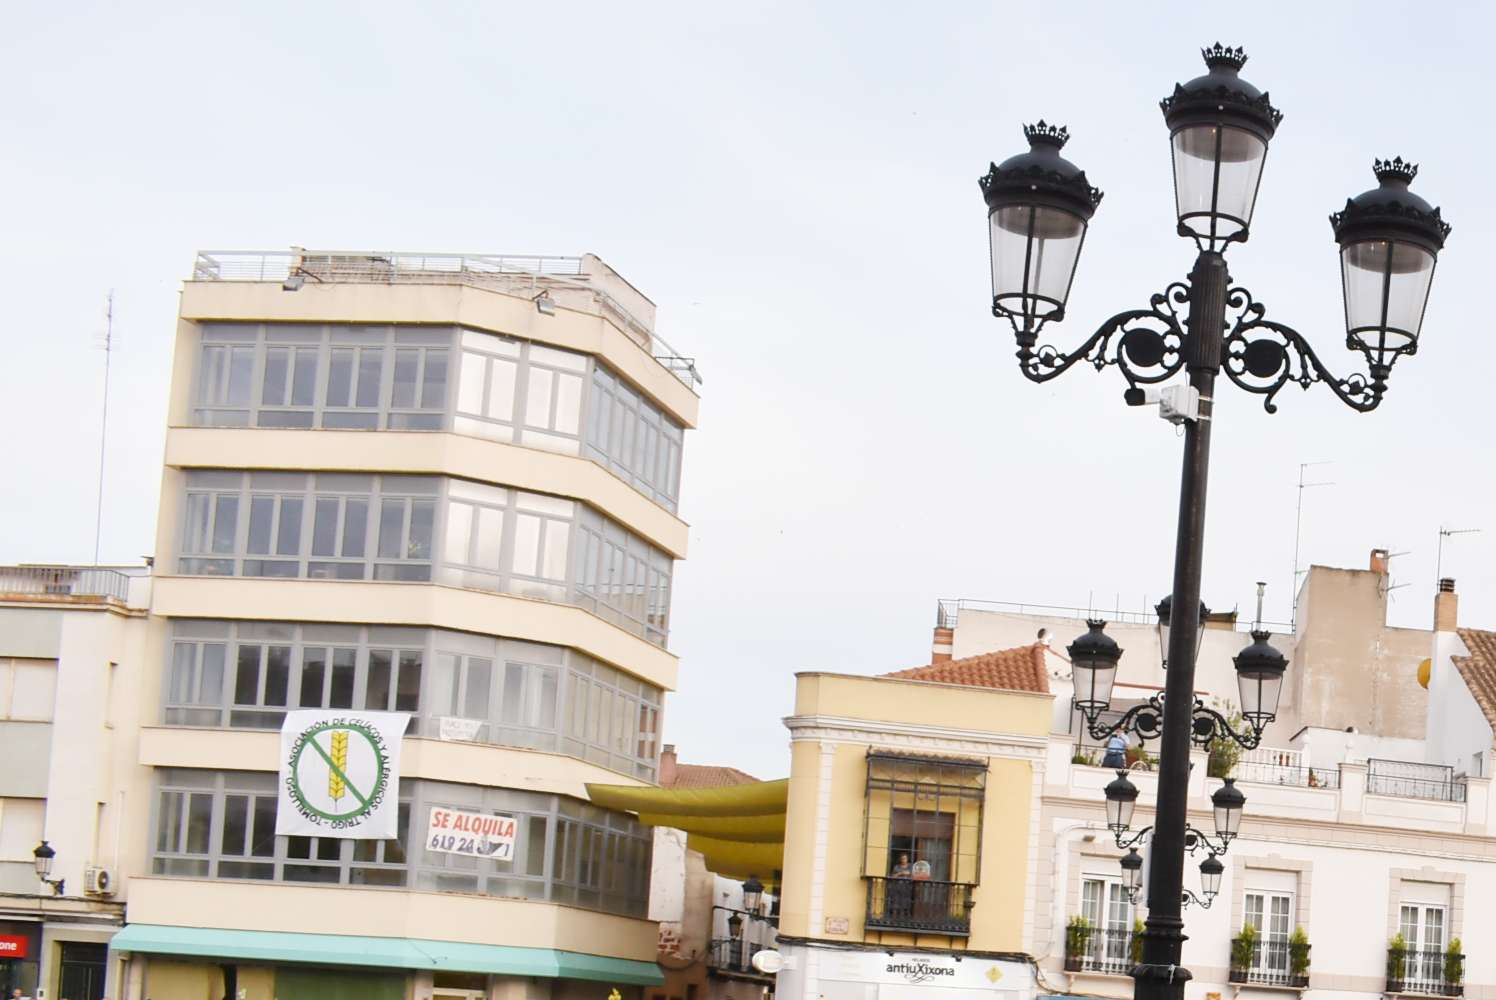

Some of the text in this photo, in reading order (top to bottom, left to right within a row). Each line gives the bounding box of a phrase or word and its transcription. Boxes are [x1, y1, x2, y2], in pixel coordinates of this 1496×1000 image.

[332, 717, 346, 726] DE
[361, 809, 373, 819] AL
[331, 816, 362, 829] TRIGO
[432, 811, 514, 838] SE ALQUILA
[431, 834, 456, 851] 619
